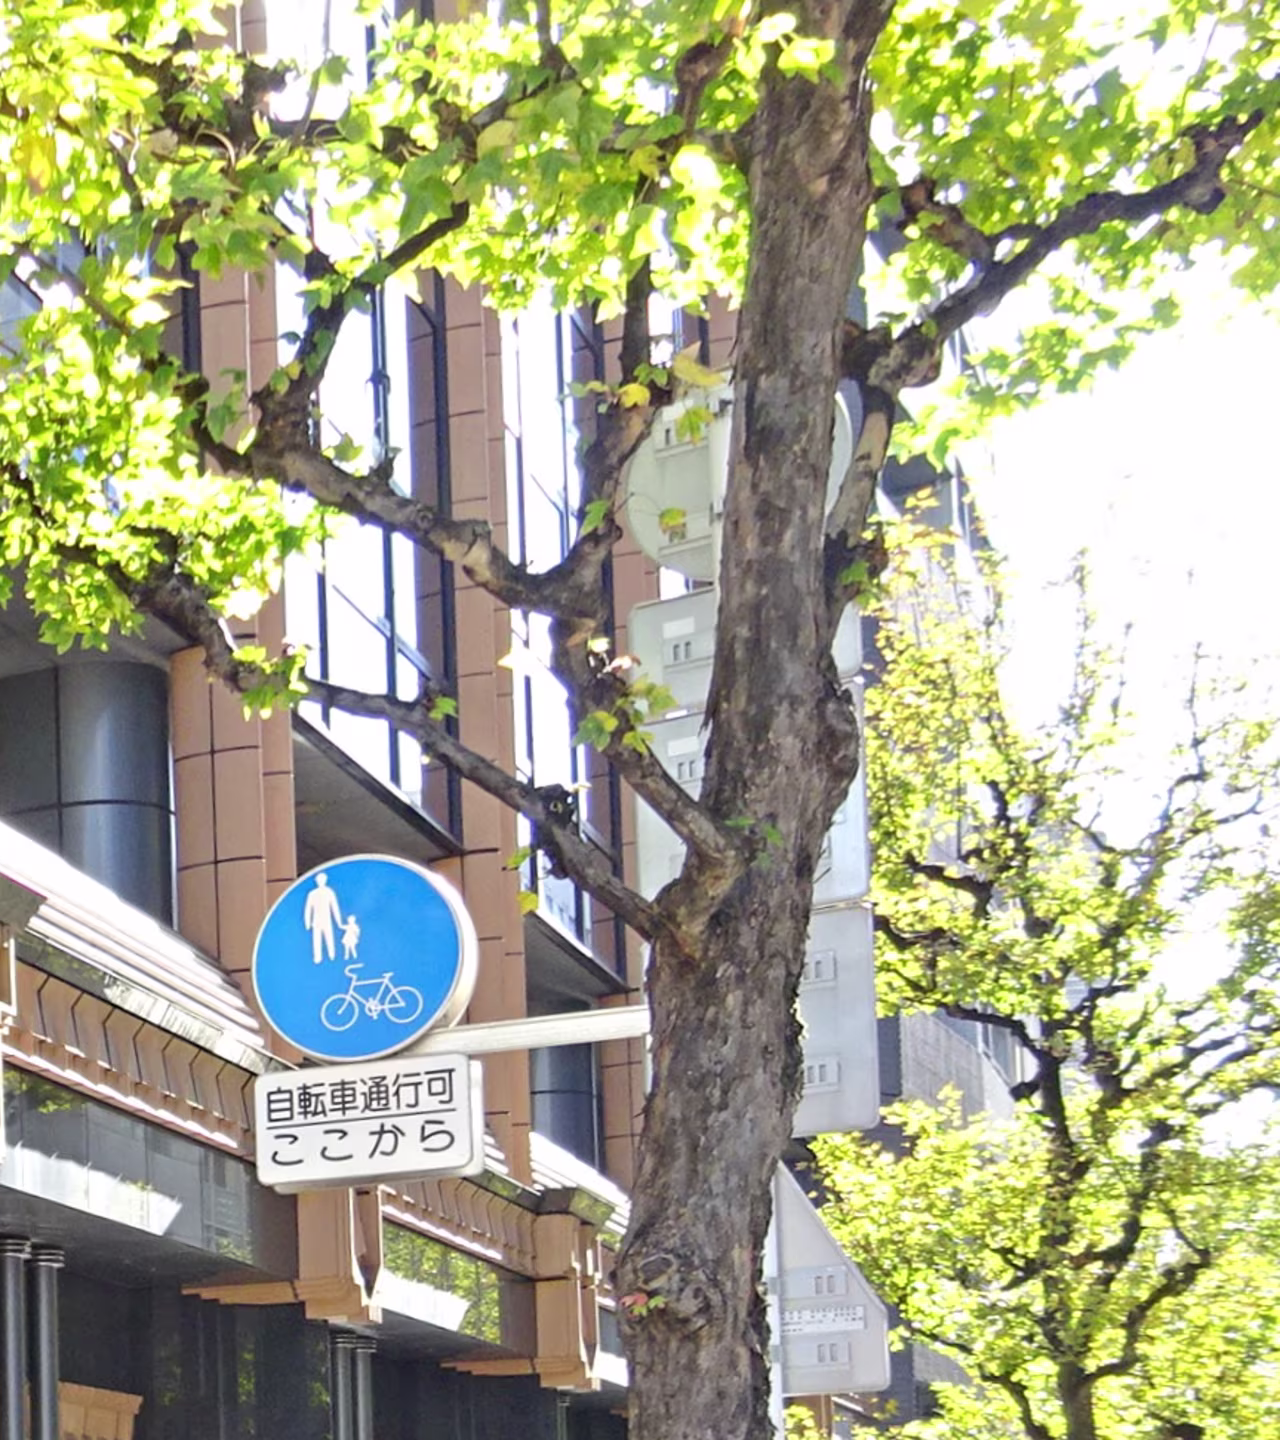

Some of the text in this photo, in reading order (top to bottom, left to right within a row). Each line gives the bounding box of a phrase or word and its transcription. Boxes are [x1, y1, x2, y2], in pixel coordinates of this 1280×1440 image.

[266, 1068, 455, 1123] 自転車通行可
[271, 1120, 455, 1166] ここから
